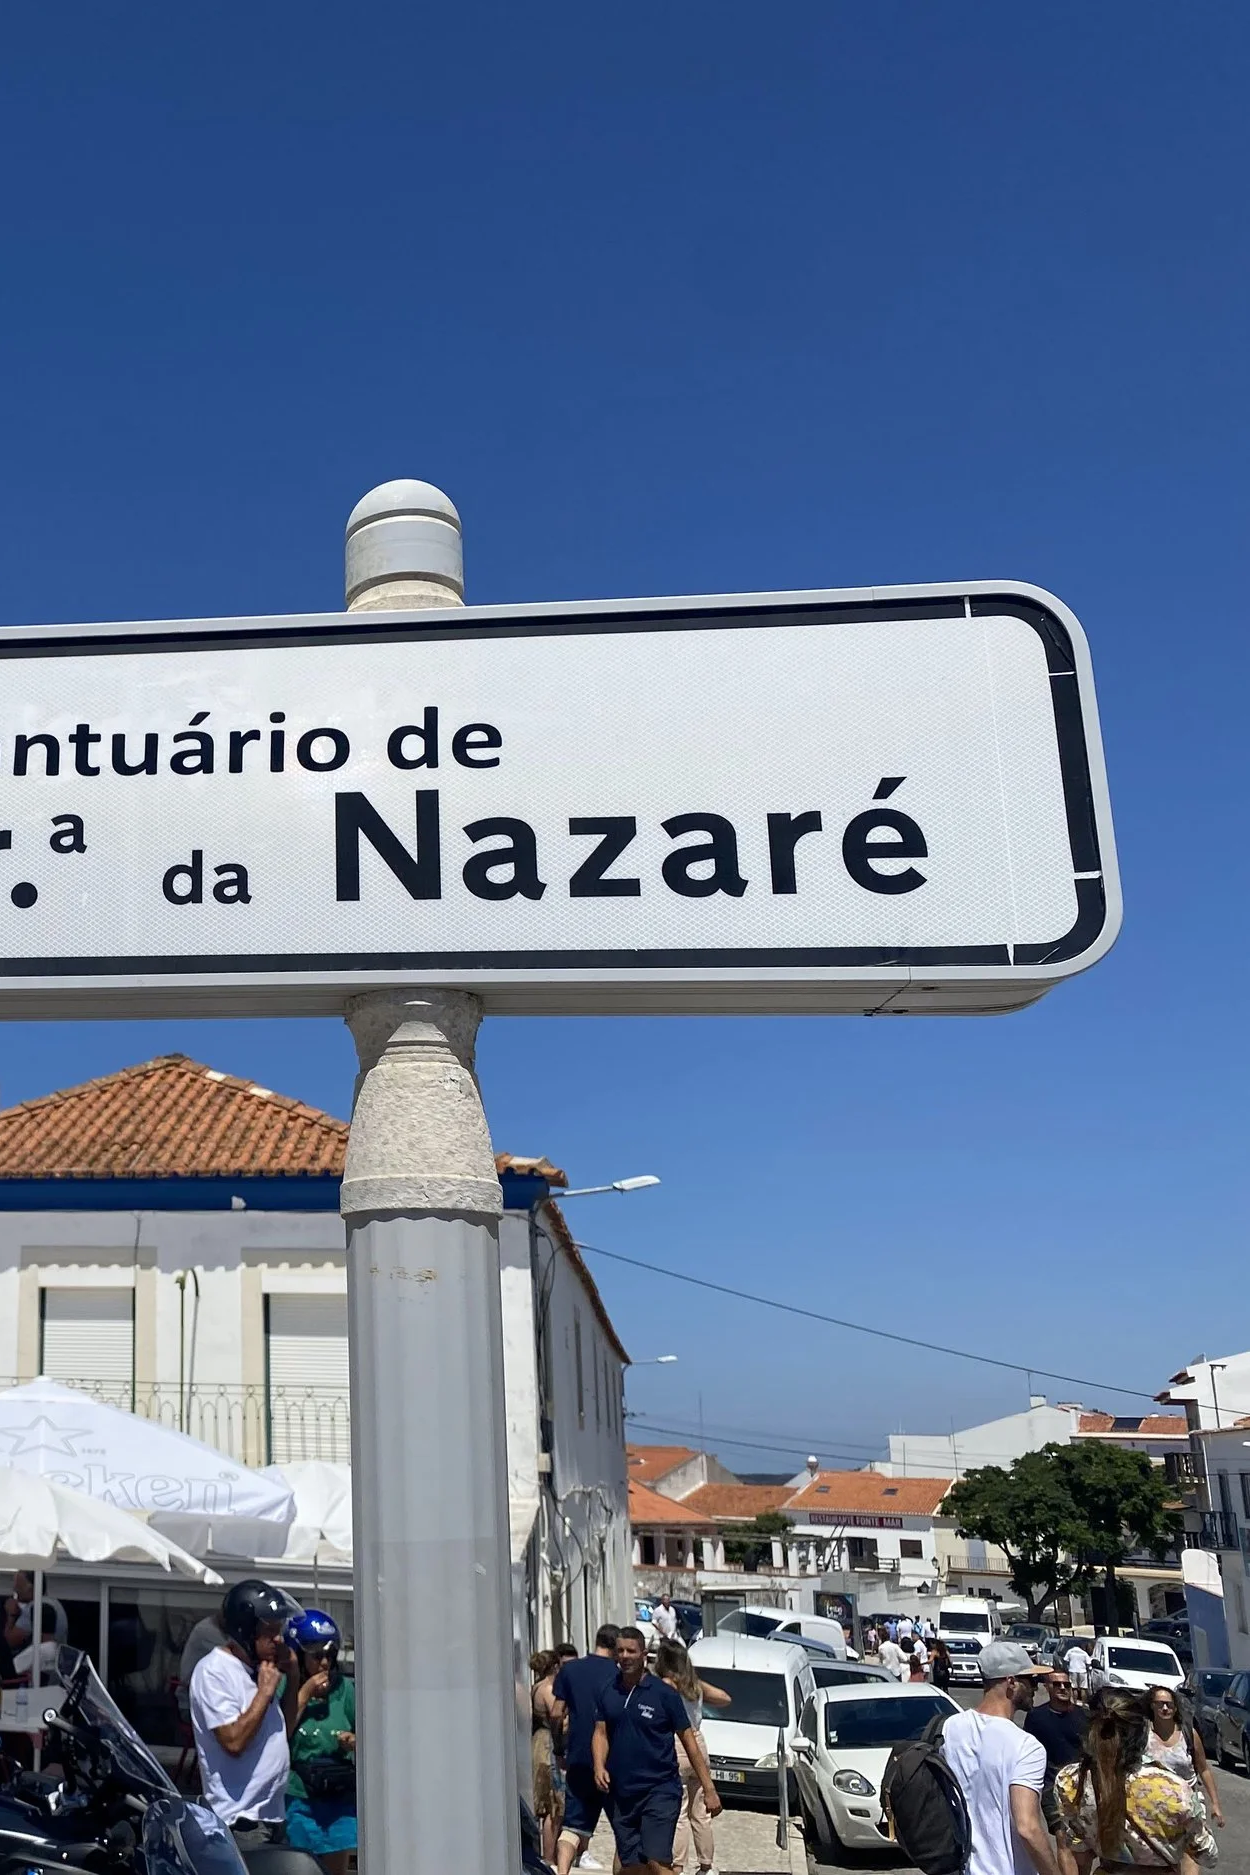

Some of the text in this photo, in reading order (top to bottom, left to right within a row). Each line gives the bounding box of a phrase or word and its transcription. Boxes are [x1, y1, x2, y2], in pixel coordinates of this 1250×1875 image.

[387, 706, 503, 771] de
[162, 849, 253, 906] da
[334, 776, 929, 902] Nazaré
[856, 1516, 879, 1527] FONTE
